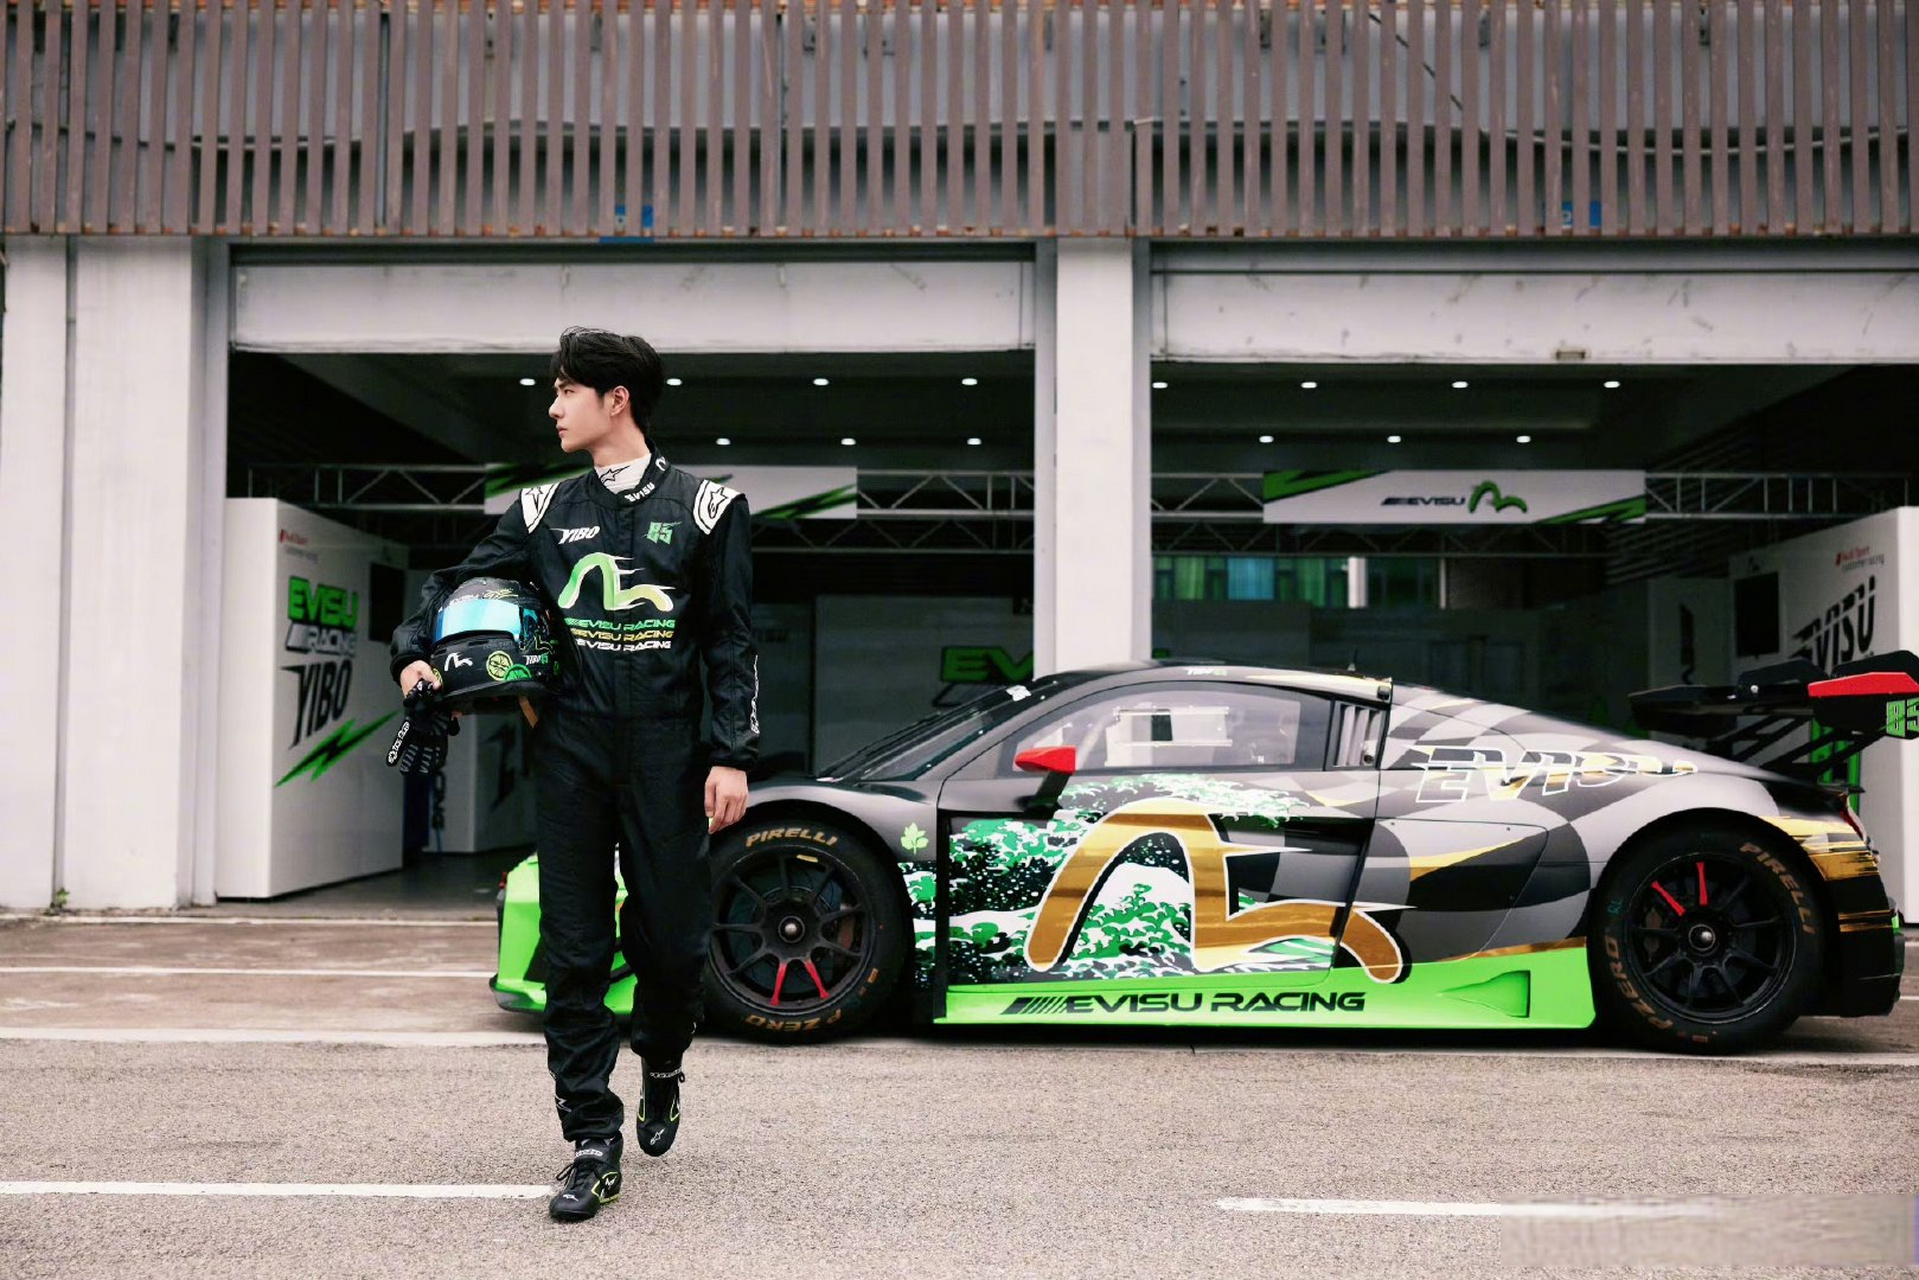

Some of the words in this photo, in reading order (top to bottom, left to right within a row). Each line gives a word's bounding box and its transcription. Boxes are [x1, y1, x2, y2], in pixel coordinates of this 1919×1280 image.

[624, 482, 655, 502] EVISU
[1407, 496, 1466, 506] EVISU
[550, 526, 601, 545] YIBO
[578, 619, 622, 631] EVISU
[623, 619, 676, 631] RACING
[578, 629, 622, 641] EVISU
[623, 630, 674, 642] RACING
[623, 640, 672, 652] RACING
[281, 658, 353, 750] YIBO
[746, 827, 837, 848] PIRELLI
[1740, 842, 1816, 935] PIRELLI
[1065, 992, 1204, 1013] EVISU
[1210, 991, 1366, 1012] RACING
[745, 1014, 821, 1032] ZERO
